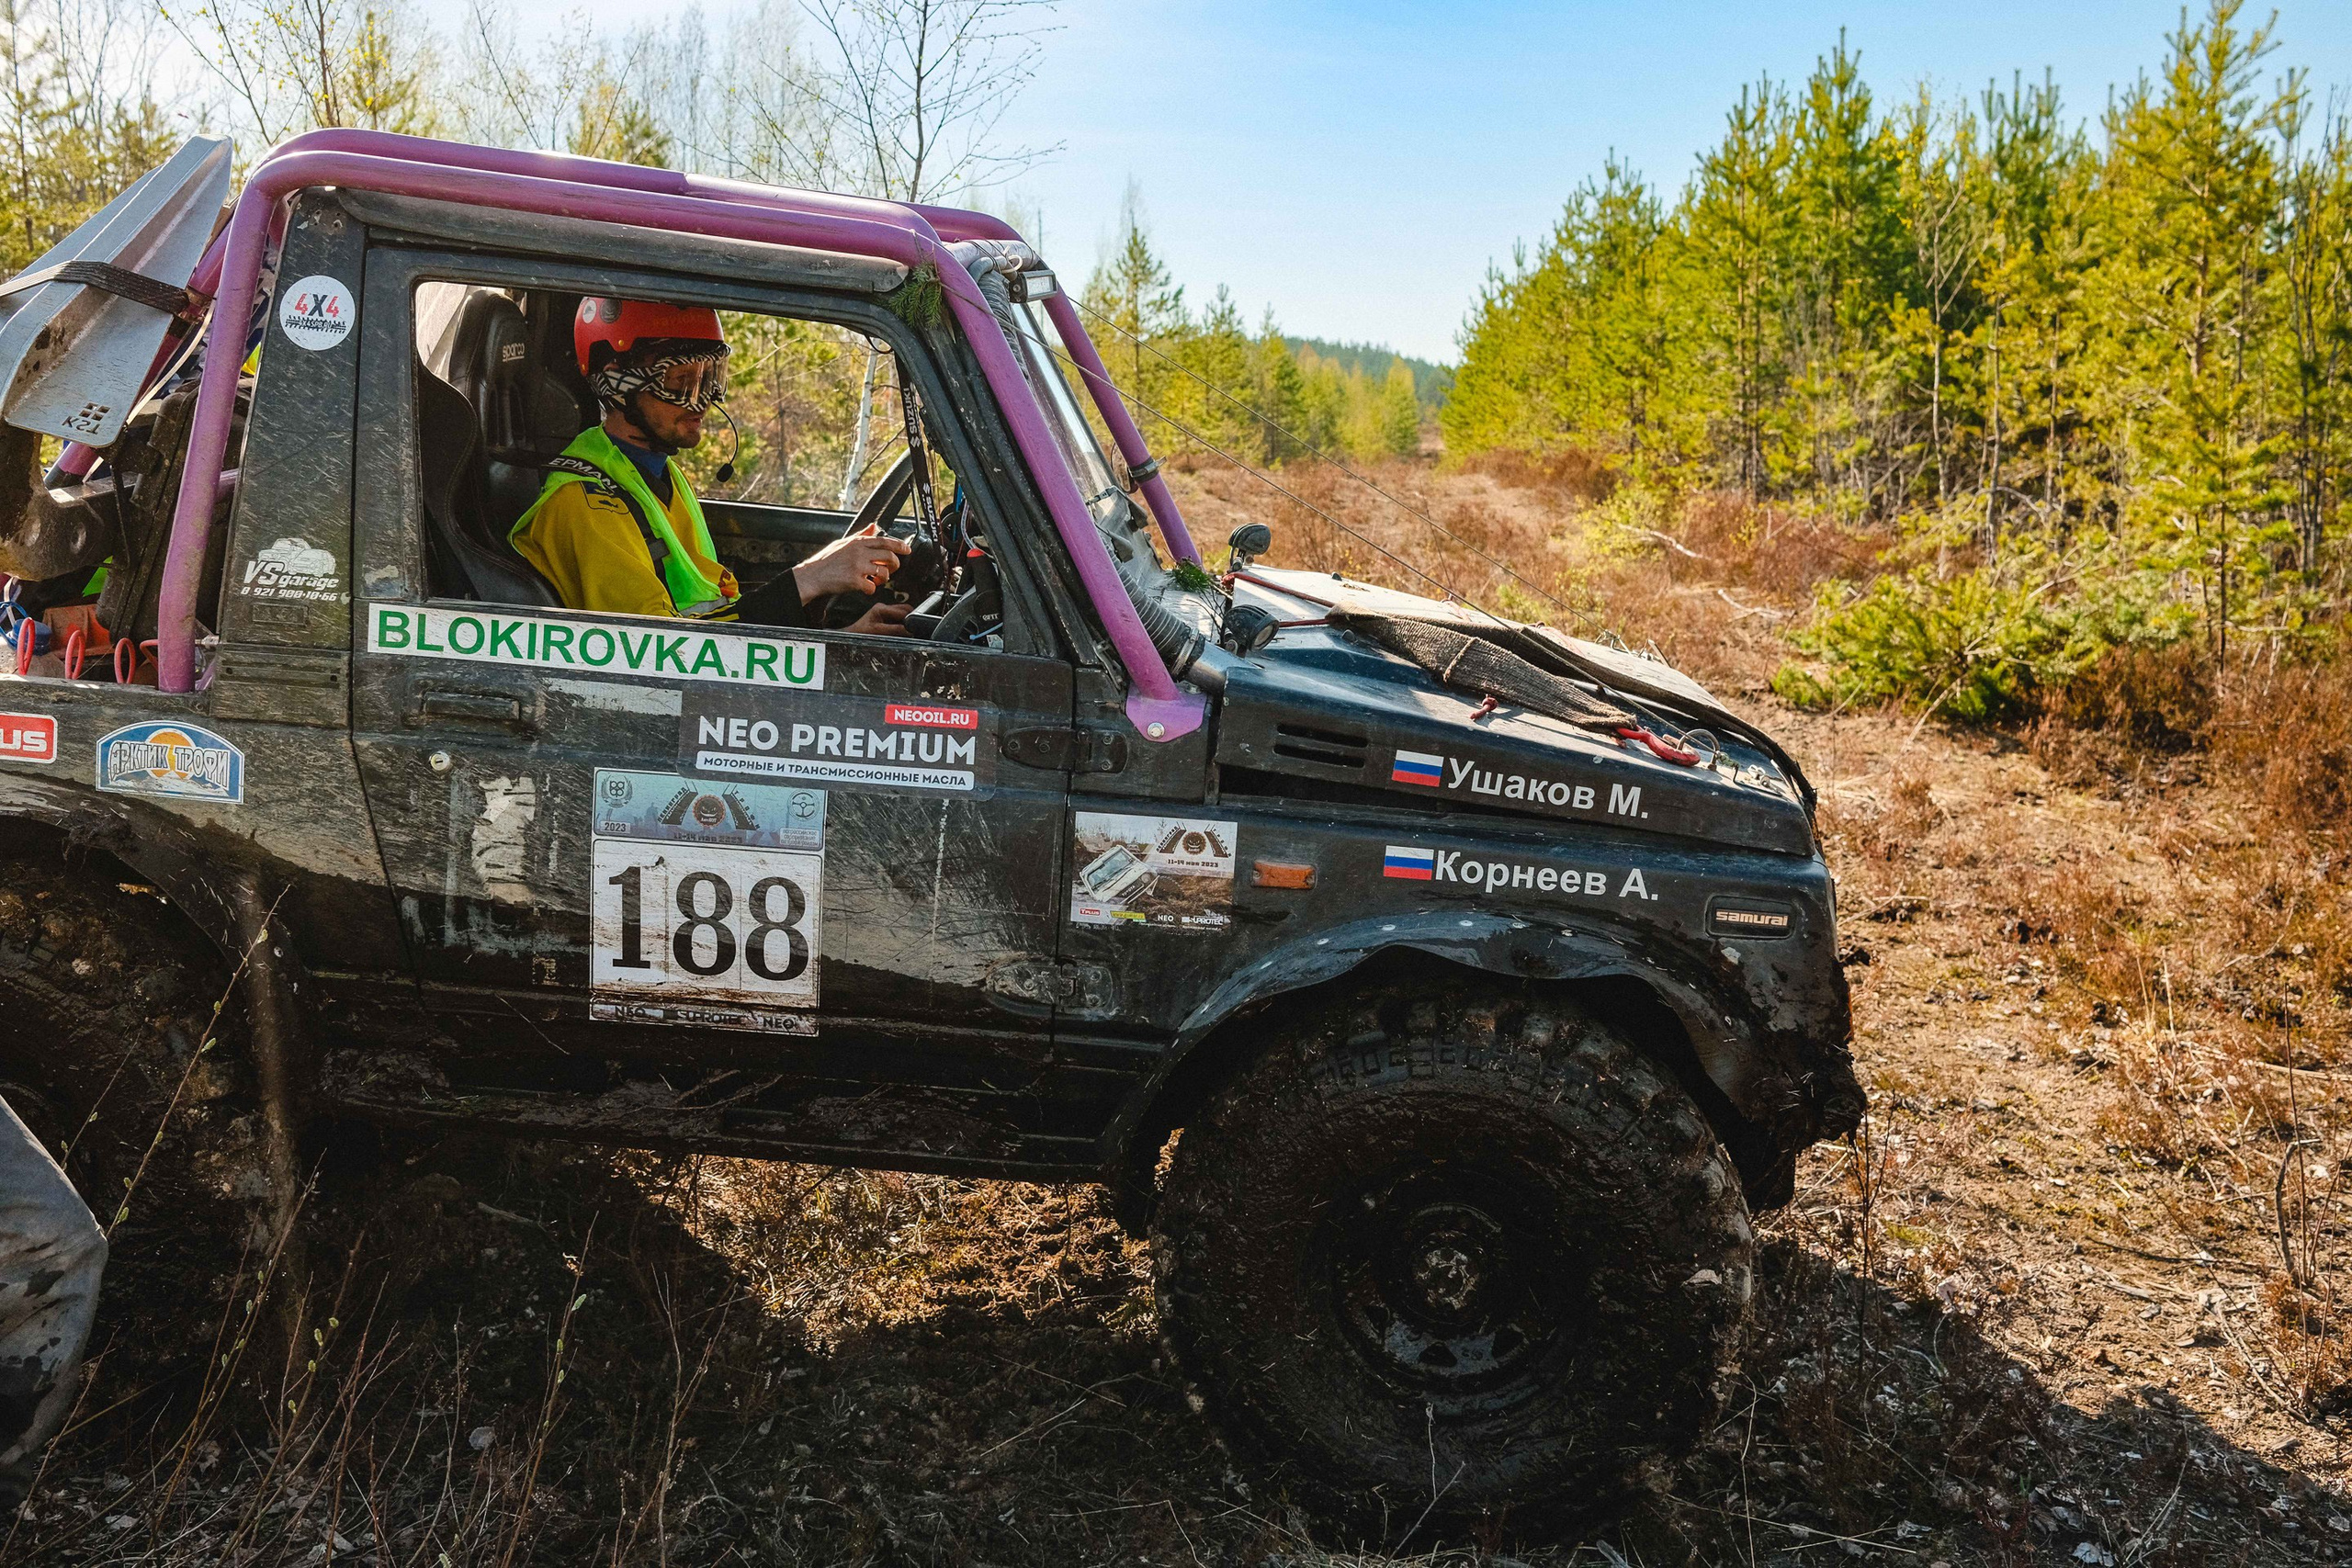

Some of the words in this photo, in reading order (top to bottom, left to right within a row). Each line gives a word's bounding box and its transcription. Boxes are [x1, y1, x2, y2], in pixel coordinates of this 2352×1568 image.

[295, 293, 340, 318] 4X4
[502, 343, 526, 362] sparco
[903, 388, 918, 434] SUZUKI
[926, 496, 938, 542] SUZUKI
[243, 560, 286, 586] VS
[277, 574, 339, 591] garage
[254, 588, 275, 597] 921
[378, 610, 815, 683] BLOKIROVKA.RU
[894, 708, 969, 726] NEOOIL.RU
[697, 716, 779, 750] NEO
[791, 723, 976, 765] PREMIUM
[175, 746, 230, 788] ТРОФИ
[704, 757, 773, 772] МОТОРНЫЕ
[775, 763, 785, 773] И
[788, 764, 919, 784] ТРАНСМИССИОННЫЕ
[922, 774, 966, 786] МАСЛА
[1448, 758, 1595, 810] Ушаков
[1608, 784, 1649, 819] М.
[605, 822, 627, 832] 2023
[1435, 851, 1607, 896] Корнеев
[1619, 868, 1658, 900] А.
[608, 865, 808, 981] 188
[1158, 914, 1174, 922] NEO
[1189, 917, 1224, 926] SUPROTEC
[1715, 911, 1789, 926] samurai
[615, 1006, 645, 1017] NEO
[763, 1016, 795, 1030] NEO
